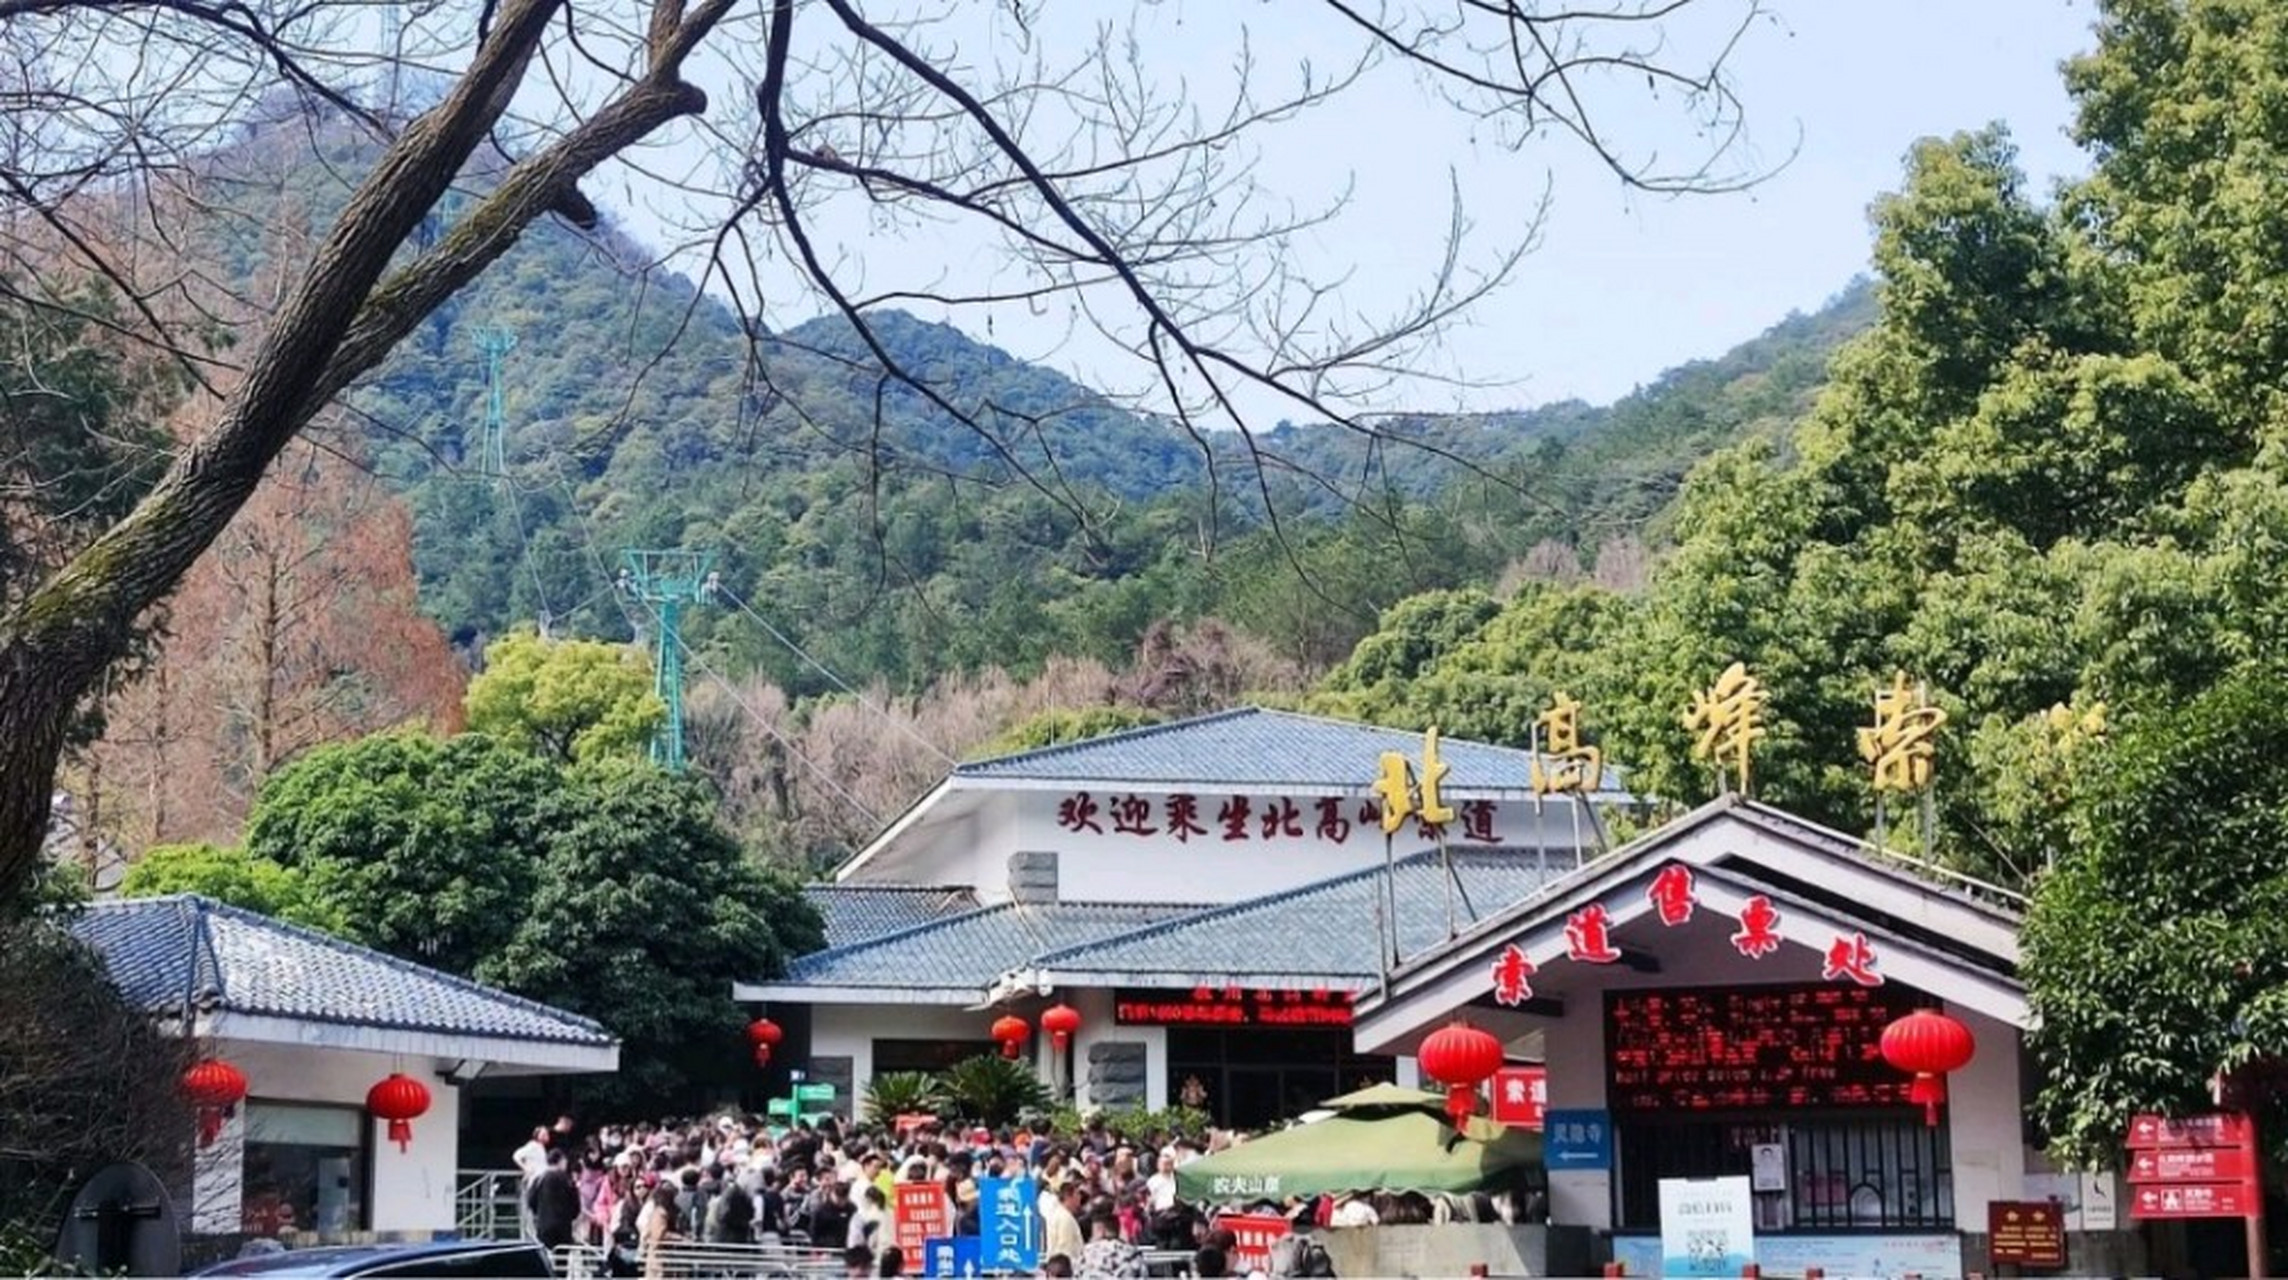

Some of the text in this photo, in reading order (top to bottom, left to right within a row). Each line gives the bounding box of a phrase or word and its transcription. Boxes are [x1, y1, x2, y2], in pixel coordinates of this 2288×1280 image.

[1491, 863, 1885, 1006] 索道售票处
[1552, 1122, 1602, 1145] 灵隐寺
